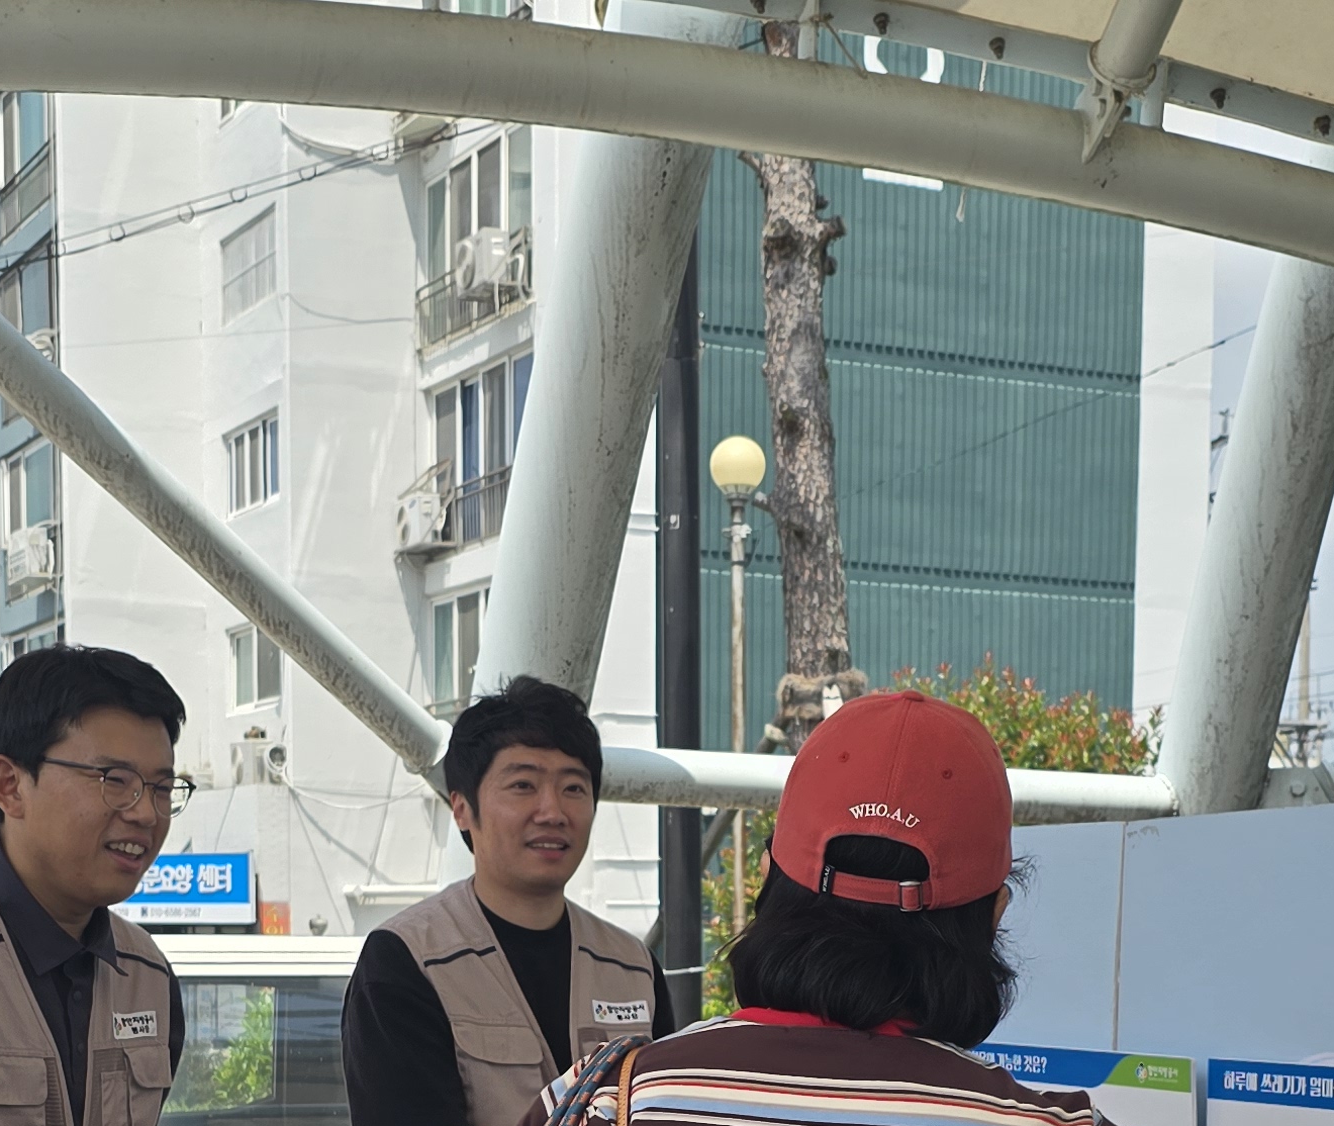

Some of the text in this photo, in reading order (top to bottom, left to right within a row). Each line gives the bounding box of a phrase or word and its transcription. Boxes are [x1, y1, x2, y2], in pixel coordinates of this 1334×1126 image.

[848, 803, 920, 829] WHO.A.U
[135, 863, 234, 895] 문요양 센터
[1023, 1054, 1048, 1074] 것은?
[1223, 1070, 1258, 1092] 하루에
[1259, 1073, 1307, 1096] 쓰레기가
